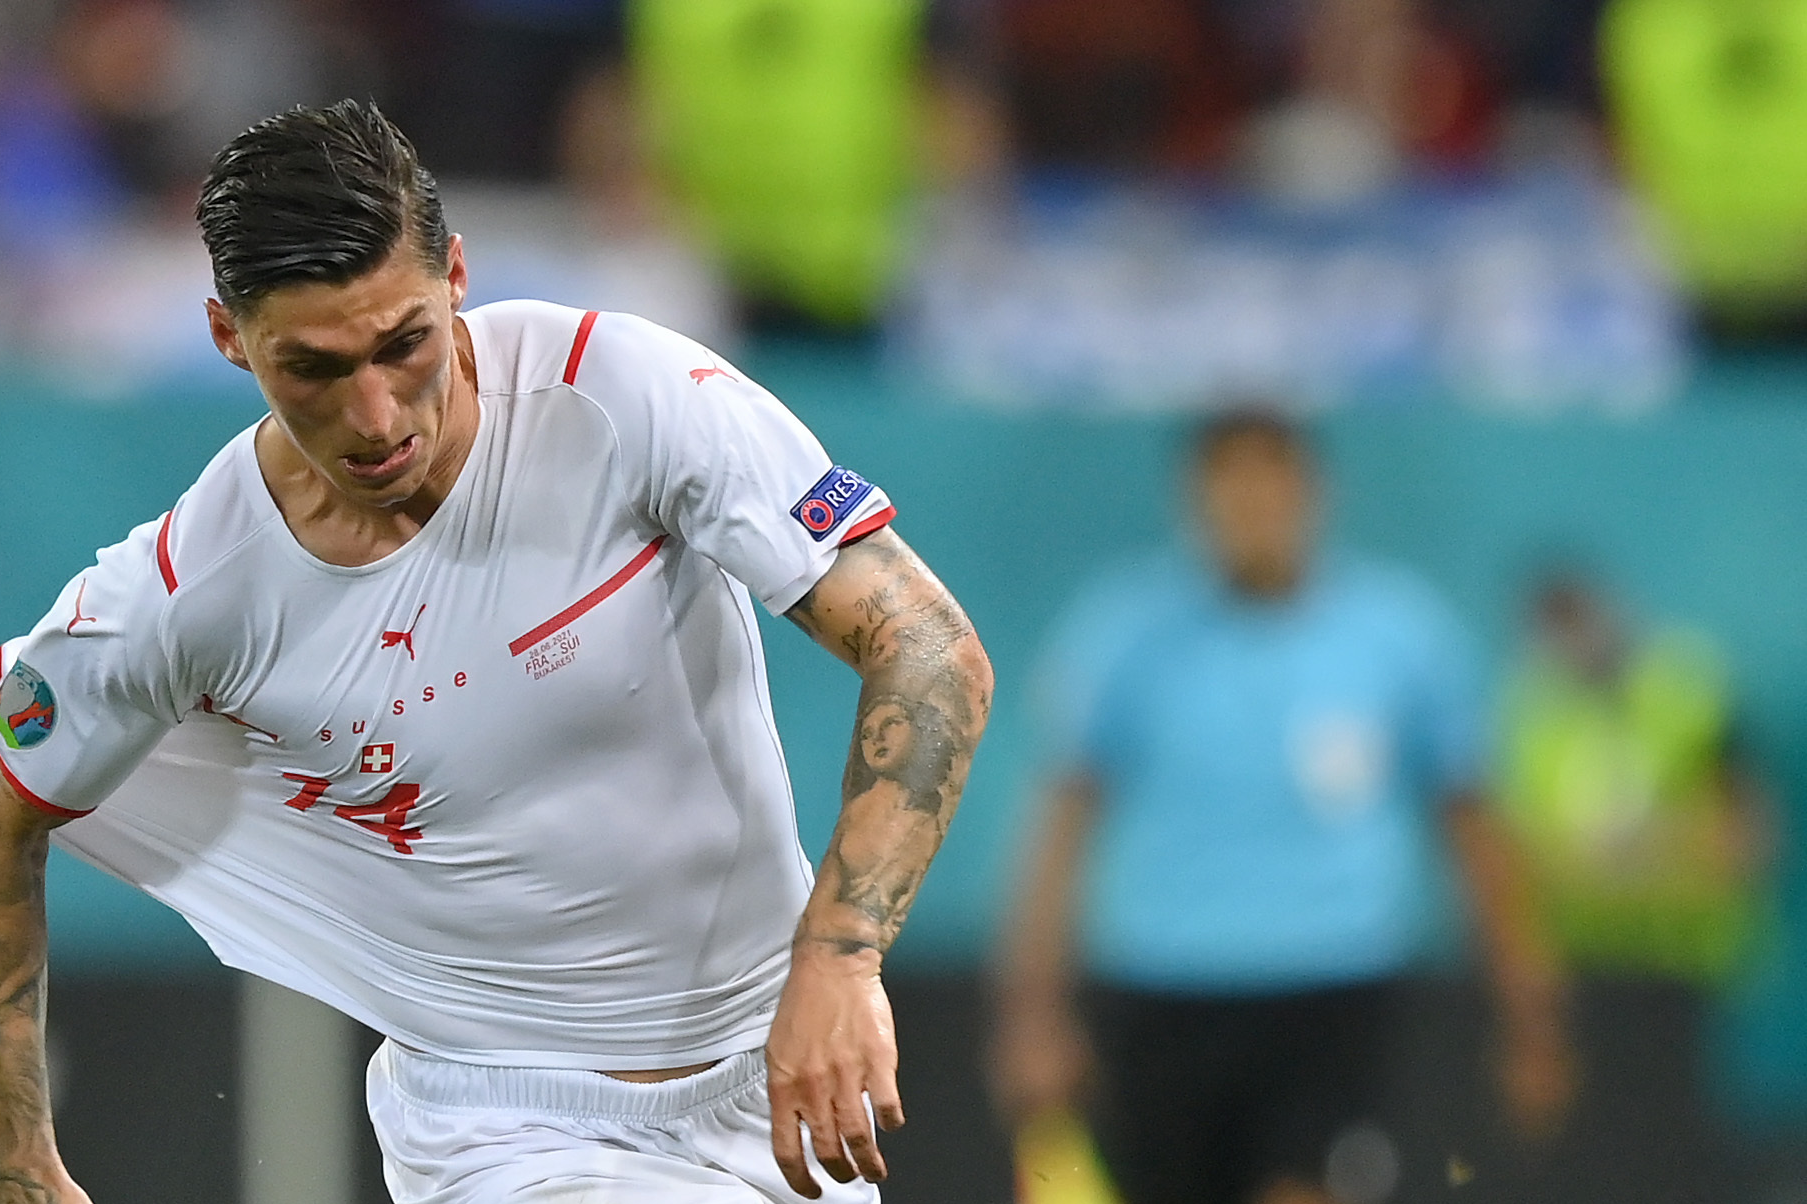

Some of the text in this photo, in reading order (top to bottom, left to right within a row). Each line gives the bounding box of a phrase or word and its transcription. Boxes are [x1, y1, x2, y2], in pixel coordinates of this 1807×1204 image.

[525, 654, 550, 675] FRA
[560, 635, 581, 655] SUI
[533, 652, 576, 681] BUKAREST
[320, 671, 468, 742] suisse
